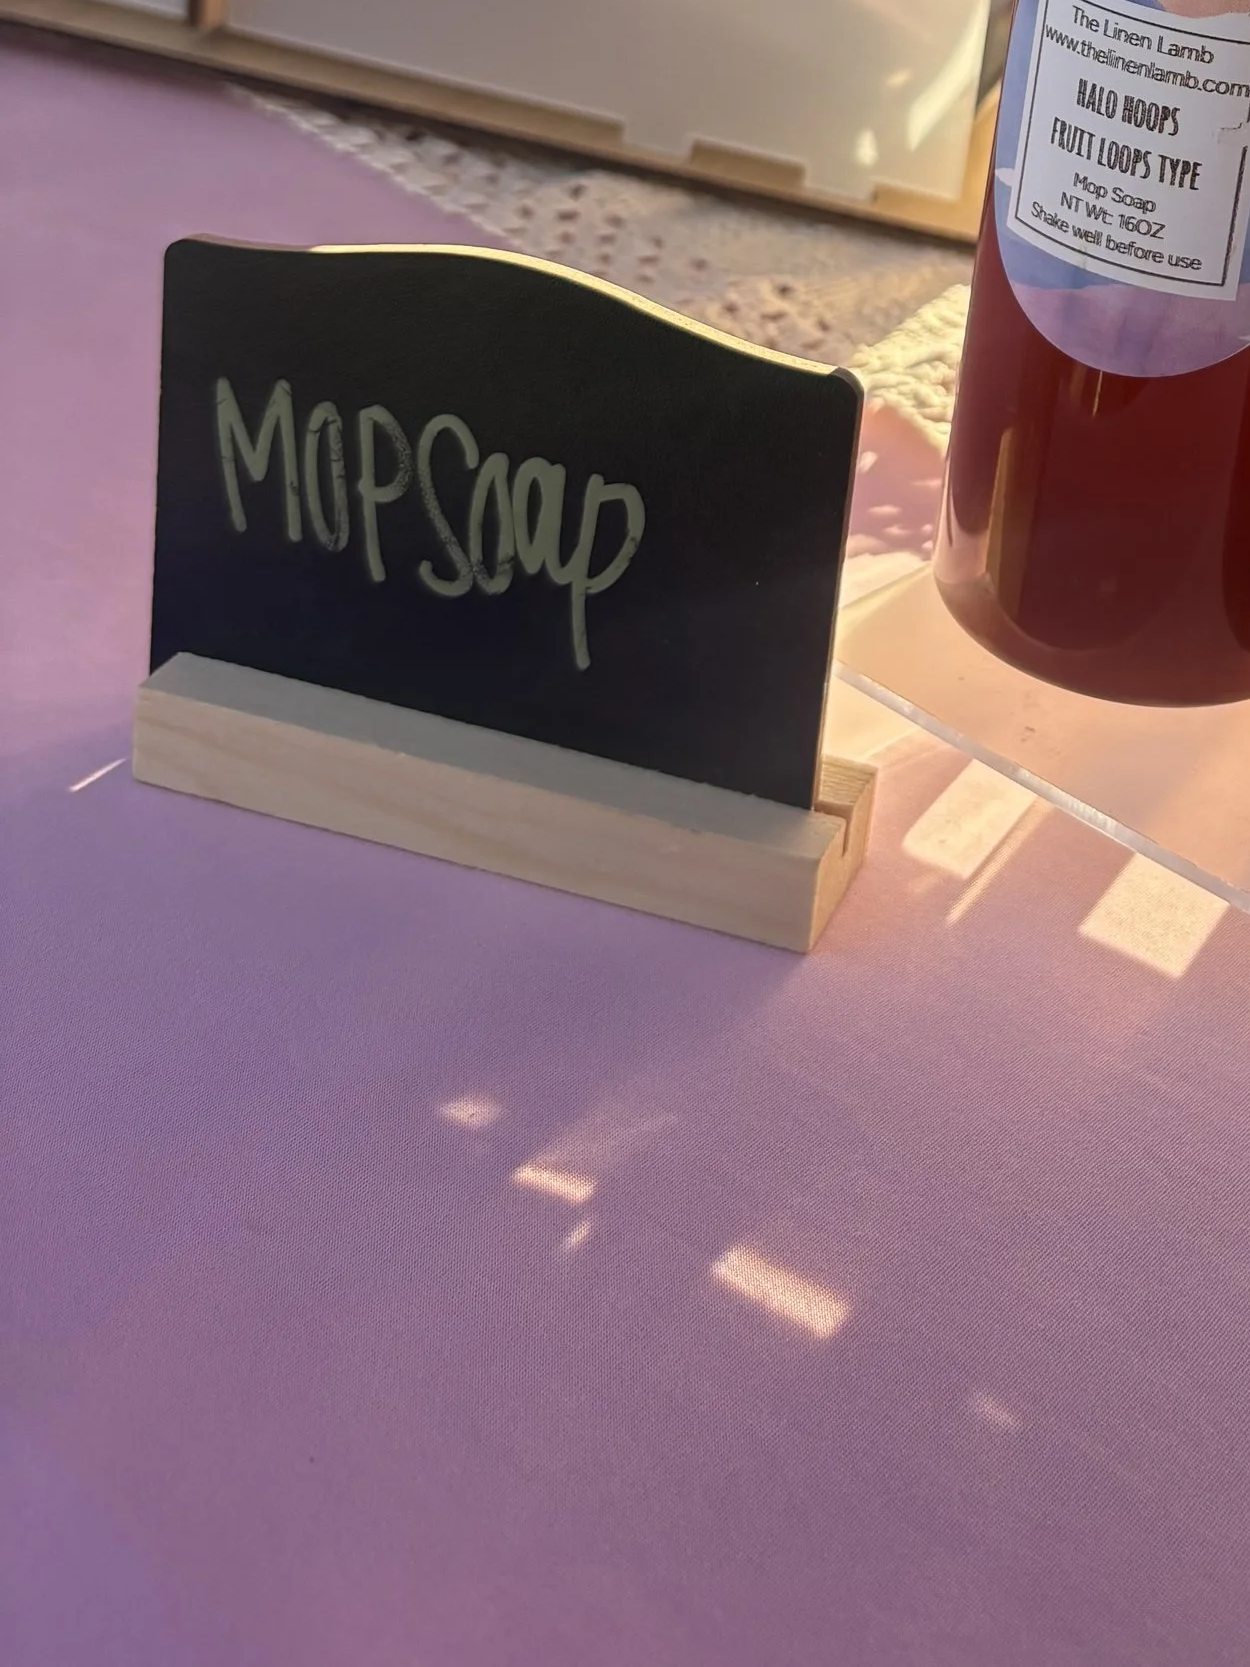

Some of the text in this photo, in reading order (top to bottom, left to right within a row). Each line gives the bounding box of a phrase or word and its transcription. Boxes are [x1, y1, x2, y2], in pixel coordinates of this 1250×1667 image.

[1045, 24, 1250, 98] www.thelinenlamb.com
[1072, 5, 1215, 65] The Linen Lamb
[1076, 78, 1181, 136] HALO HOOPS
[1050, 117, 1203, 191] FRUIT LOOPS TYPE
[1060, 191, 1084, 214] NT
[1073, 172, 1157, 215] Mop Soap
[1031, 201, 1203, 271] Shake well before use
